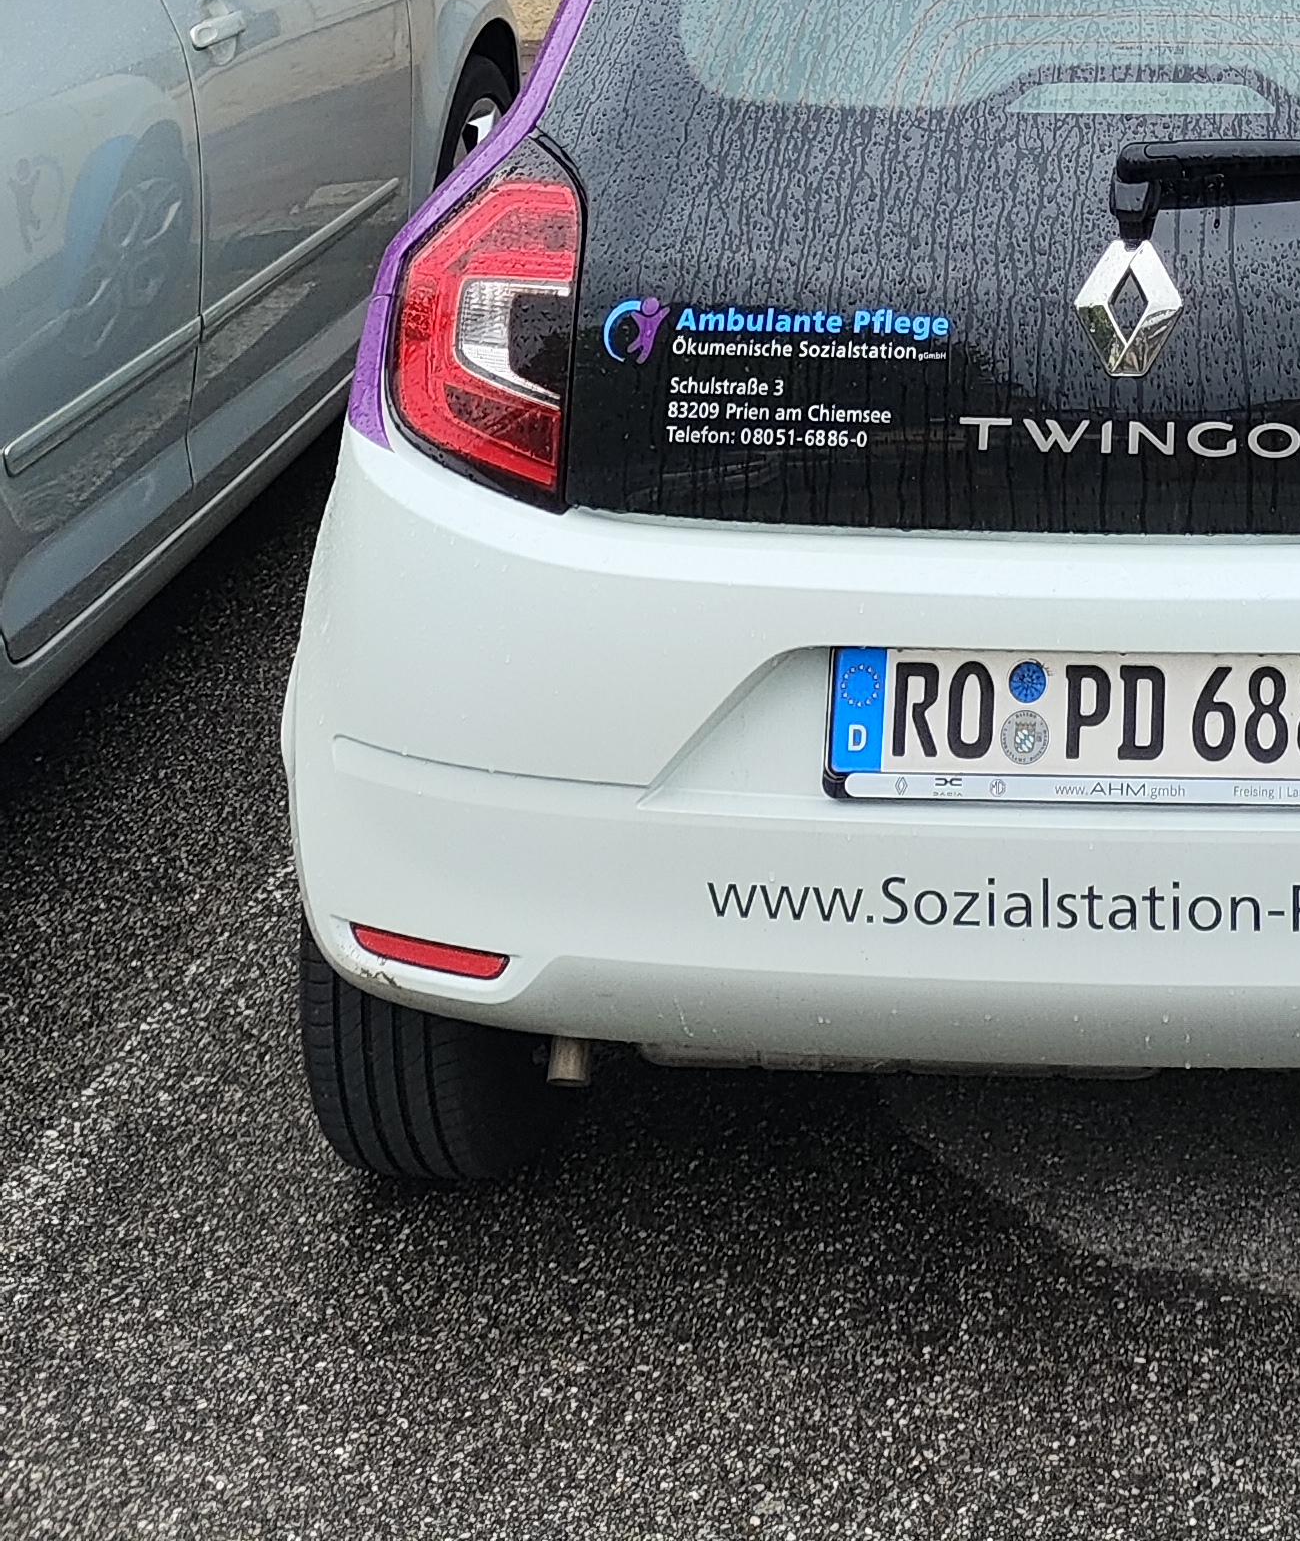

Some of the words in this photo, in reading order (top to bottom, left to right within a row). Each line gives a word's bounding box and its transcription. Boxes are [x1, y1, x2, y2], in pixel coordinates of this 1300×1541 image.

[675, 307, 843, 334] Ambulante
[853, 309, 950, 341] Pflege
[672, 335, 793, 358] Ökumenische
[798, 340, 917, 360] Sozialstation
[918, 350, 947, 362] gGmbH
[669, 377, 769, 397] Schulstraße
[773, 378, 784, 397] 3
[667, 401, 720, 420] 83209
[725, 402, 770, 421] Prien
[774, 406, 802, 422] am
[807, 404, 892, 424] Chiemsee
[665, 425, 736, 445] Telefon:
[740, 427, 868, 449] 08051-6886-0
[892, 660, 996, 760] RO
[1064, 663, 1166, 761] PD
[847, 723, 868, 752] D
[1054, 781, 1186, 799] www.AHM.gmbh
[1233, 785, 1275, 799] Freising
